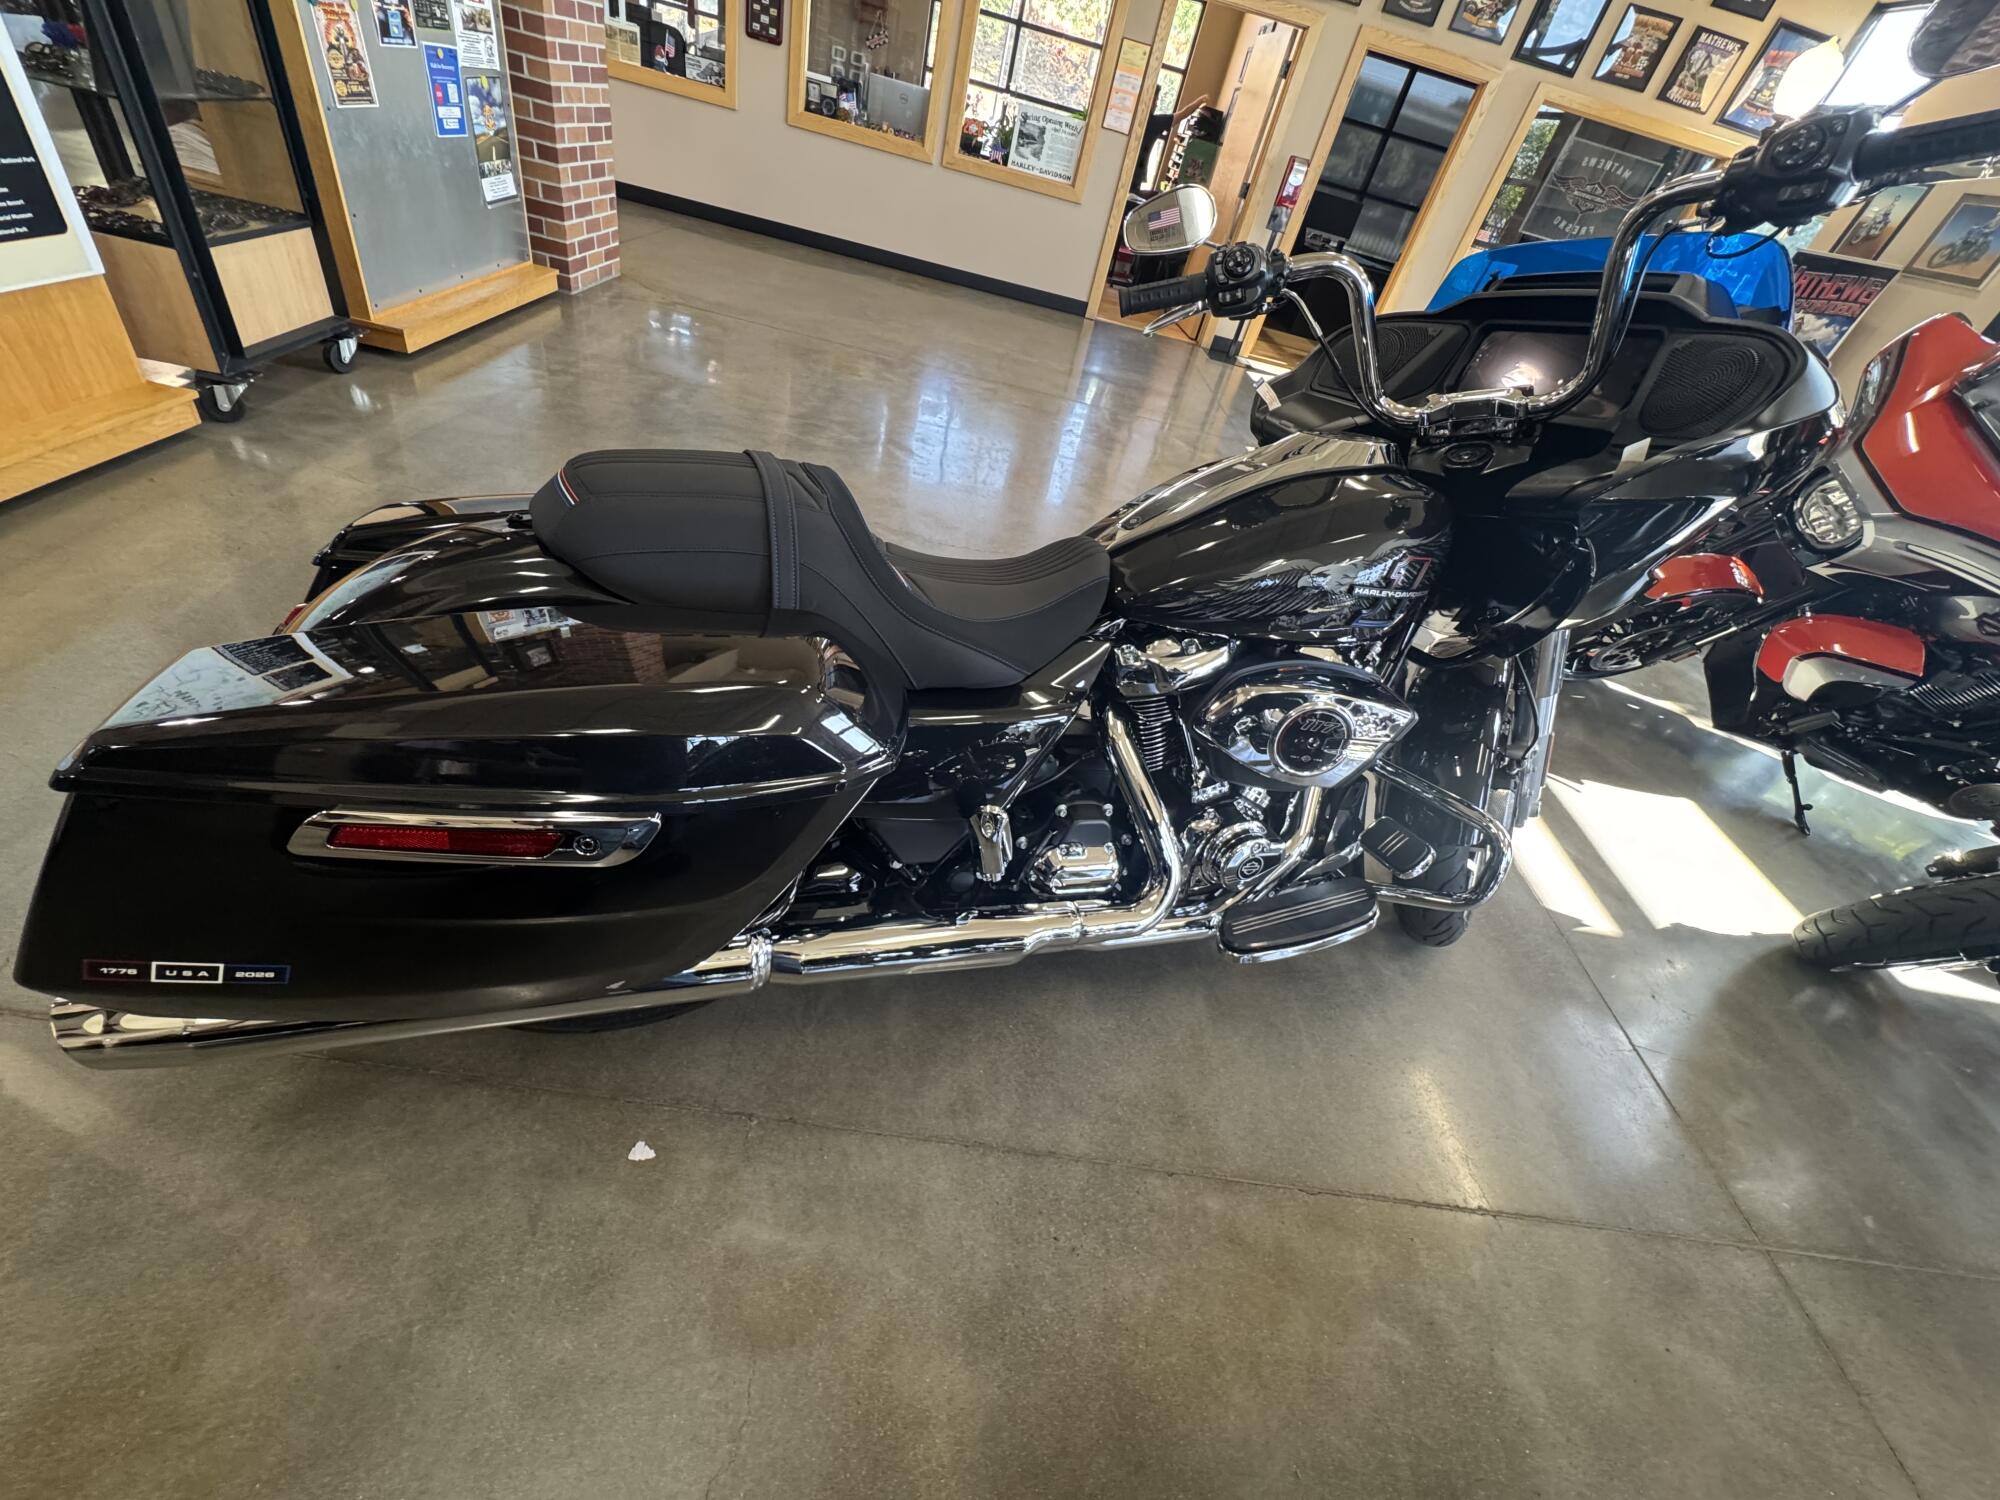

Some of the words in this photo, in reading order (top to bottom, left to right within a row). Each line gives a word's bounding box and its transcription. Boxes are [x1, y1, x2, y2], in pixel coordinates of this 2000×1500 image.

[1700, 32, 1741, 53] MATHEWS
[1041, 115, 1063, 128] Opening
[1300, 718, 1341, 734] 117
[100, 967, 138, 975] 1776
[235, 971, 275, 979] 2026
